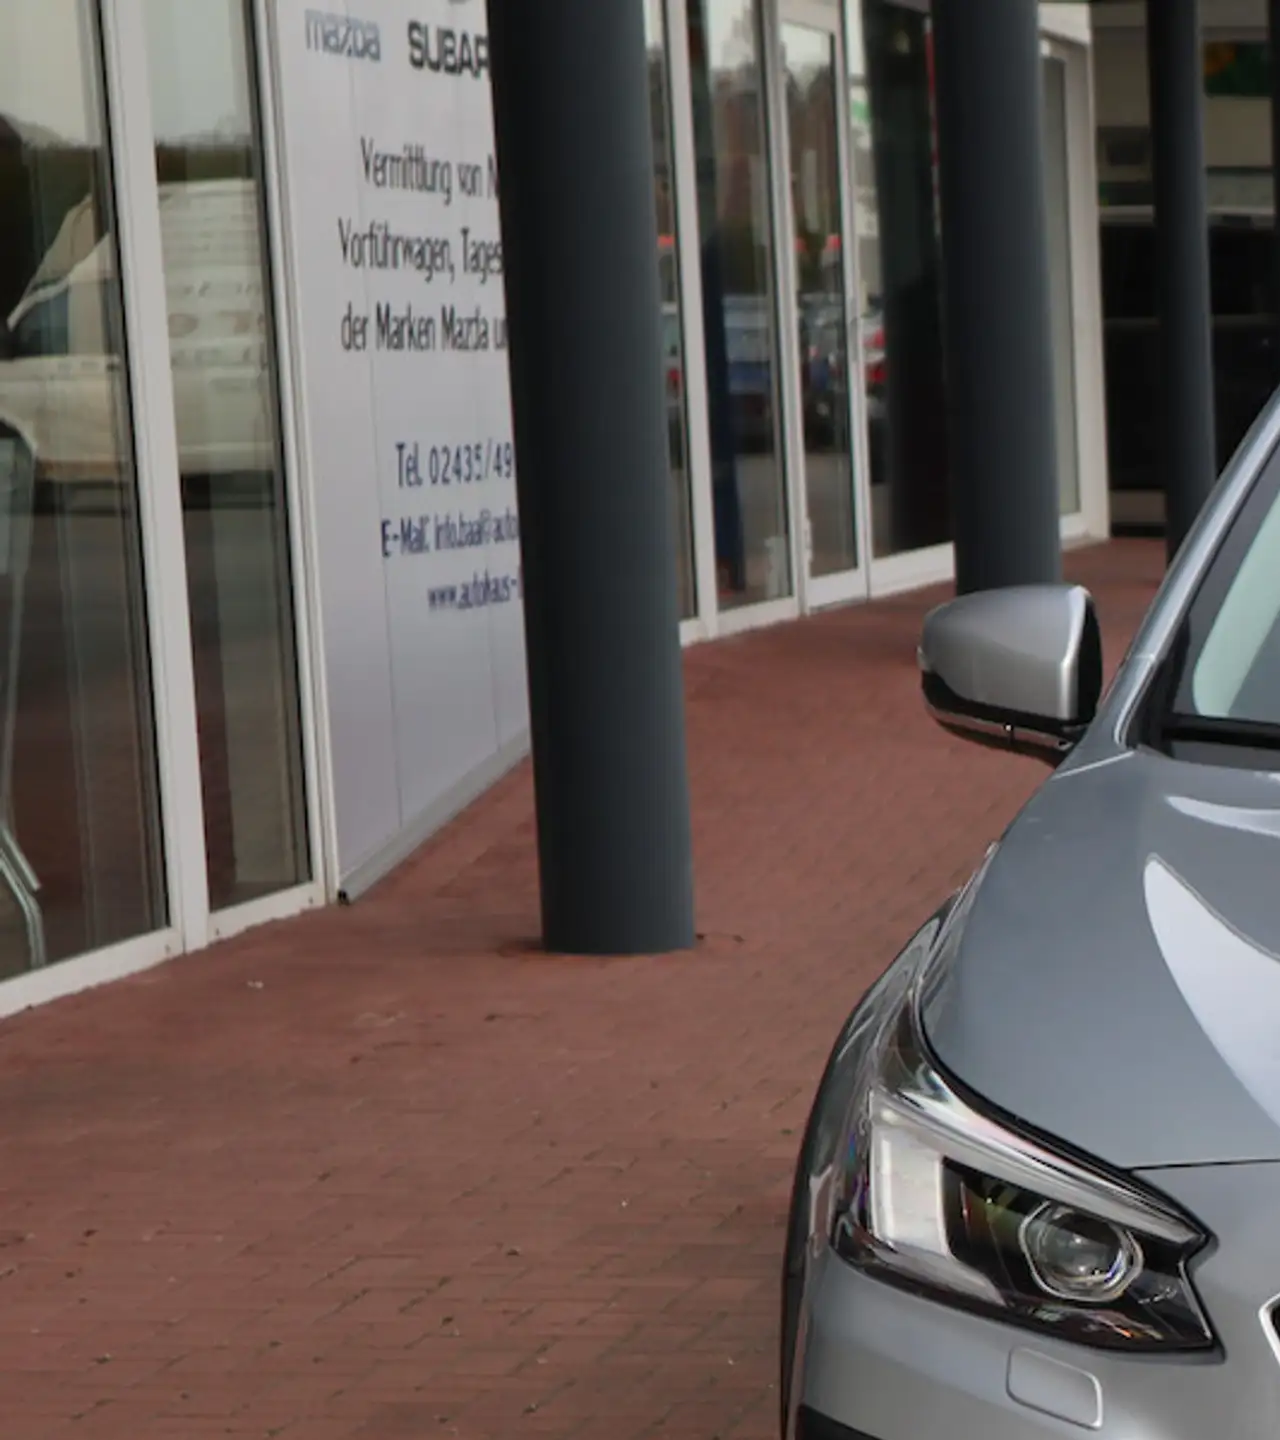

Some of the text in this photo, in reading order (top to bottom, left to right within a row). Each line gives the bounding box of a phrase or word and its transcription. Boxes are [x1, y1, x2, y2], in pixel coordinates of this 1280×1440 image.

[360, 135, 452, 206] Vermittlung
[456, 162, 483, 198] von
[338, 216, 455, 285] Vorführwagen,
[341, 300, 368, 351] der
[376, 300, 436, 351] Marken
[441, 302, 489, 351] Mazda
